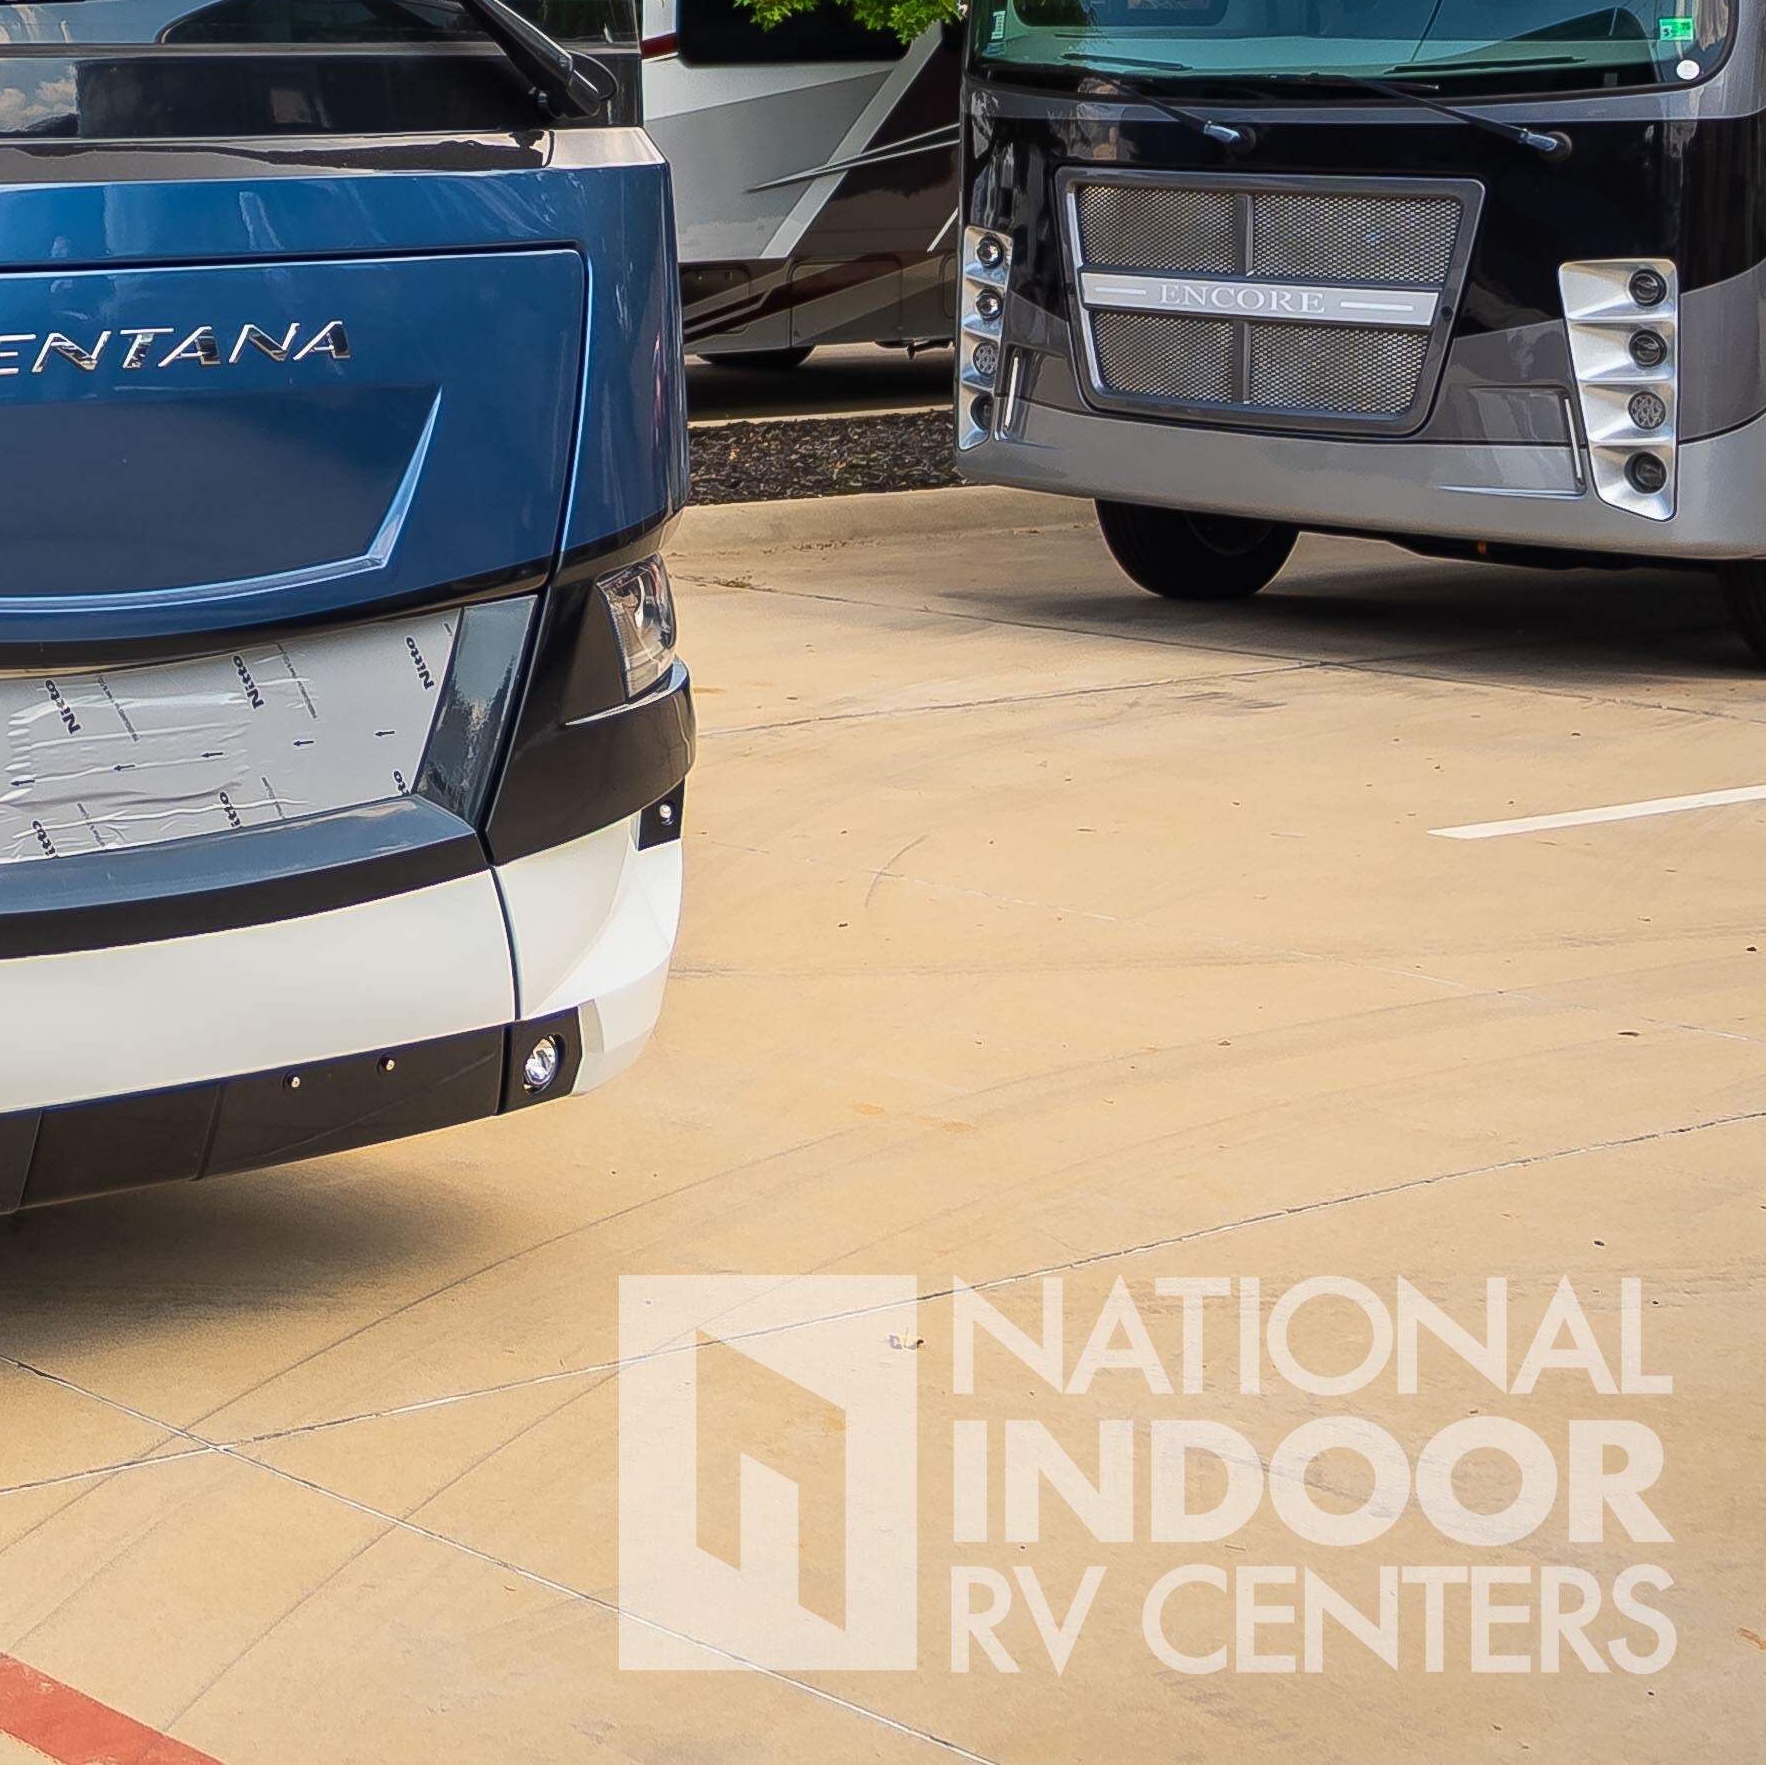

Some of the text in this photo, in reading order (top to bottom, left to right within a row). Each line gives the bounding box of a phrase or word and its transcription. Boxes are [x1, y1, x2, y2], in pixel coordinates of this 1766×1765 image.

[1159, 284, 1325, 313] ENCORE
[232, 655, 265, 710] Nitto
[405, 636, 435, 691] Nitto
[45, 679, 81, 735] Nitto
[220, 791, 243, 828] itto
[32, 820, 57, 857] itto
